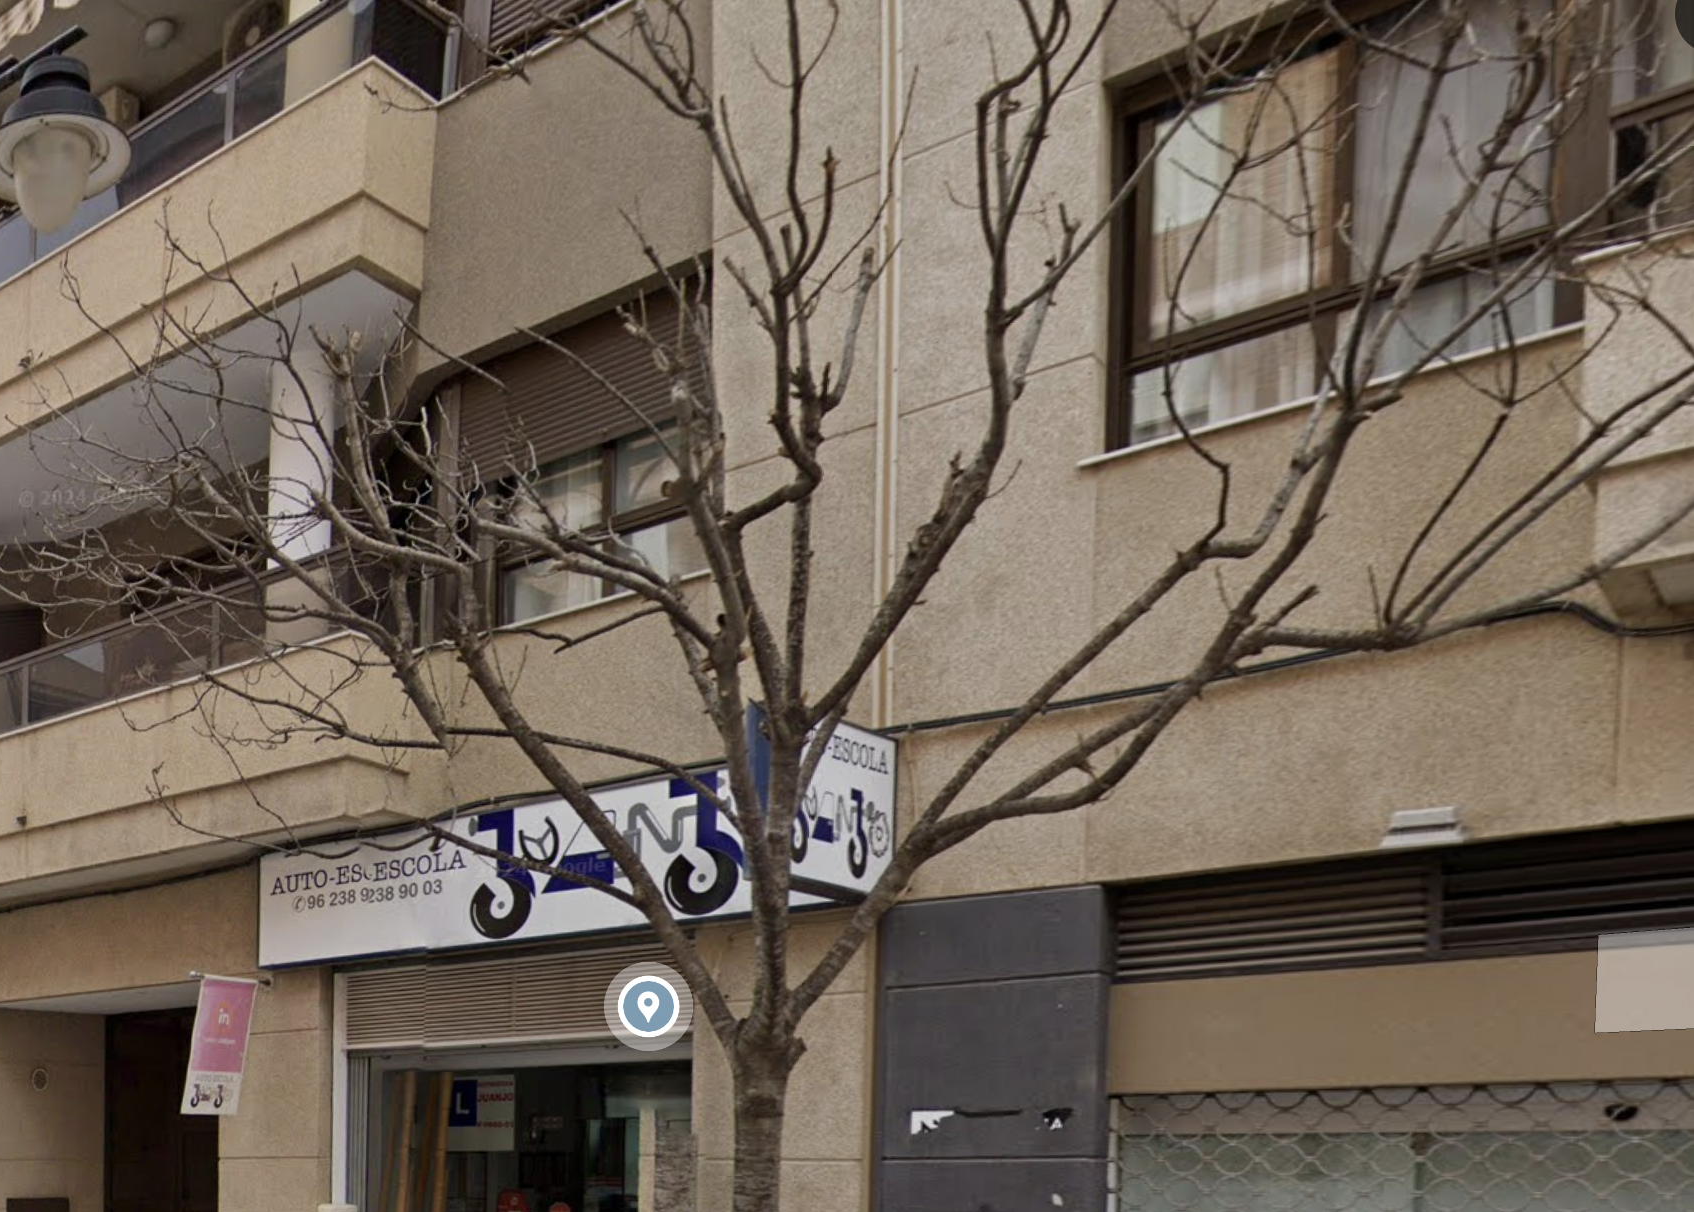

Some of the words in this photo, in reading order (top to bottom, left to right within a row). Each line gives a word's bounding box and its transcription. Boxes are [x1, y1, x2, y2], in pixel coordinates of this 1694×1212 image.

[307, 894, 325, 910] 96
[329, 890, 356, 907] 238
[399, 882, 419, 899] 90
[423, 879, 443, 895] 03
[456, 1093, 470, 1115] L
